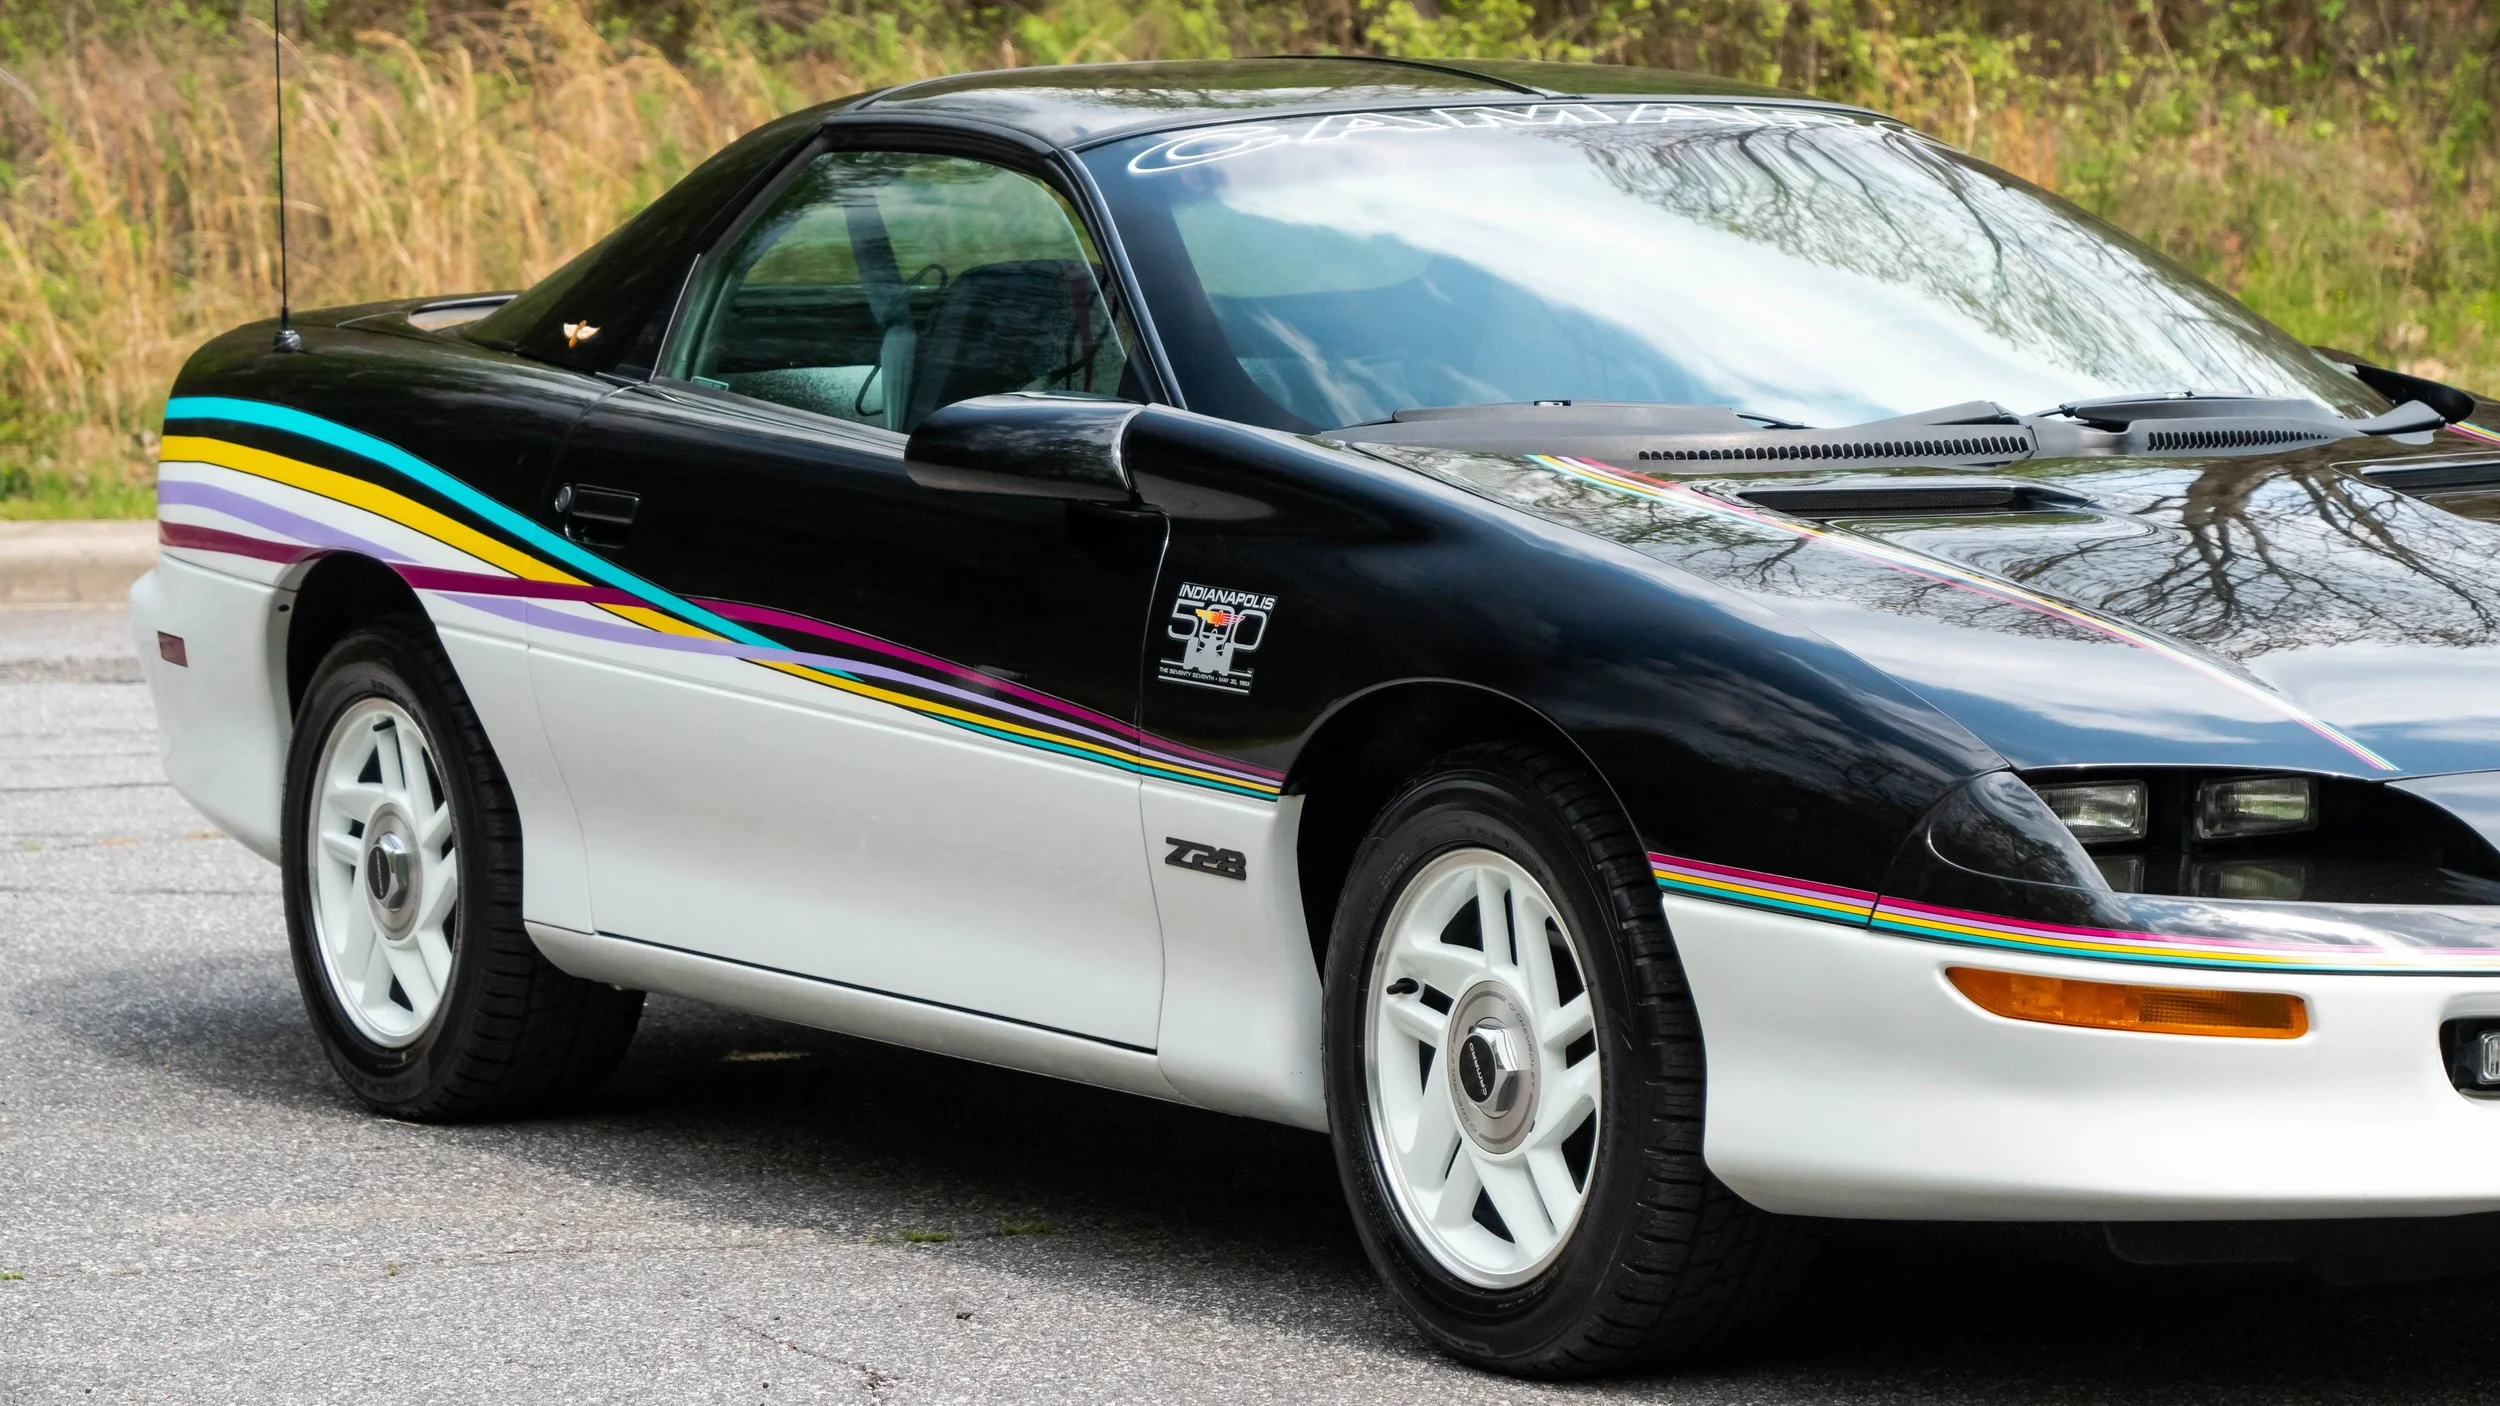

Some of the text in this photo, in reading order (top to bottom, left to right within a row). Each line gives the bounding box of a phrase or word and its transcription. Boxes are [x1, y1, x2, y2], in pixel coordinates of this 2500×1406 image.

[1179, 584, 1276, 610] INDIANAPOLIS
[1169, 669, 1192, 677] SEVENTY
[1192, 672, 1214, 680] SEVENTH
[1165, 837, 1246, 881] Z28
[1469, 1042, 1488, 1096] CAMARO
[1515, 1013, 1536, 1090] CHEVROLET
